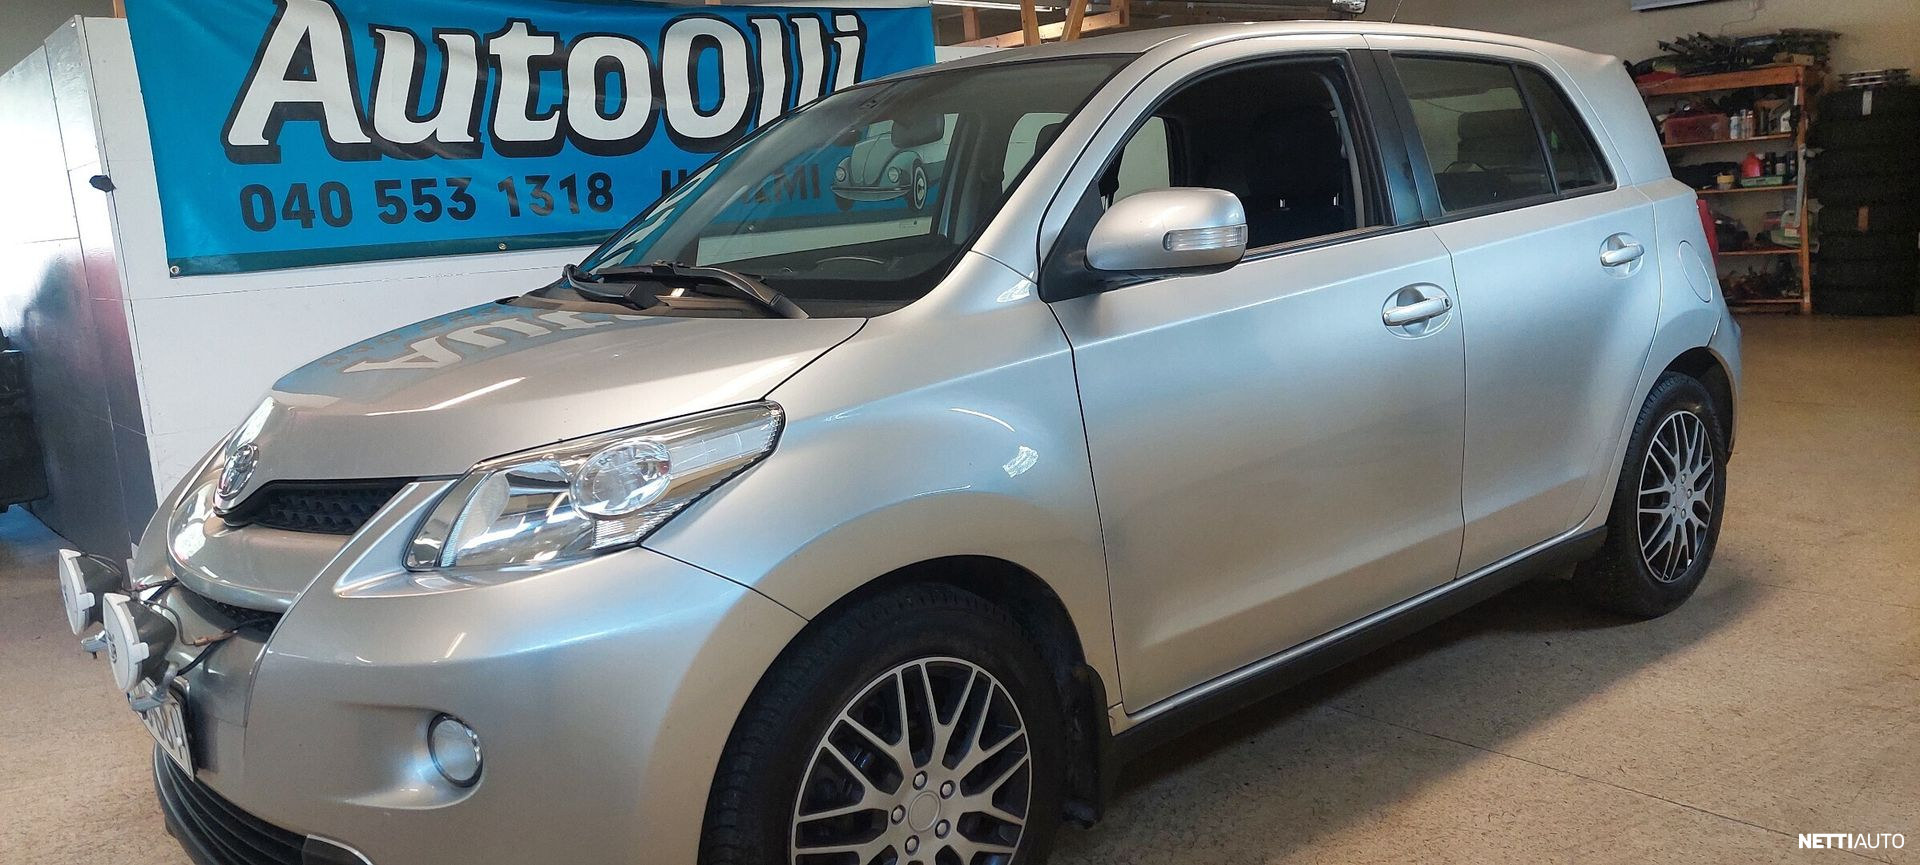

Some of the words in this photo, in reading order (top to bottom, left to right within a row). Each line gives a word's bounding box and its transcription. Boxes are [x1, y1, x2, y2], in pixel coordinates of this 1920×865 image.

[222, 0, 867, 163] AutoOlli
[239, 180, 353, 232] 040
[374, 176, 477, 225] 553
[497, 171, 614, 218] 1318
